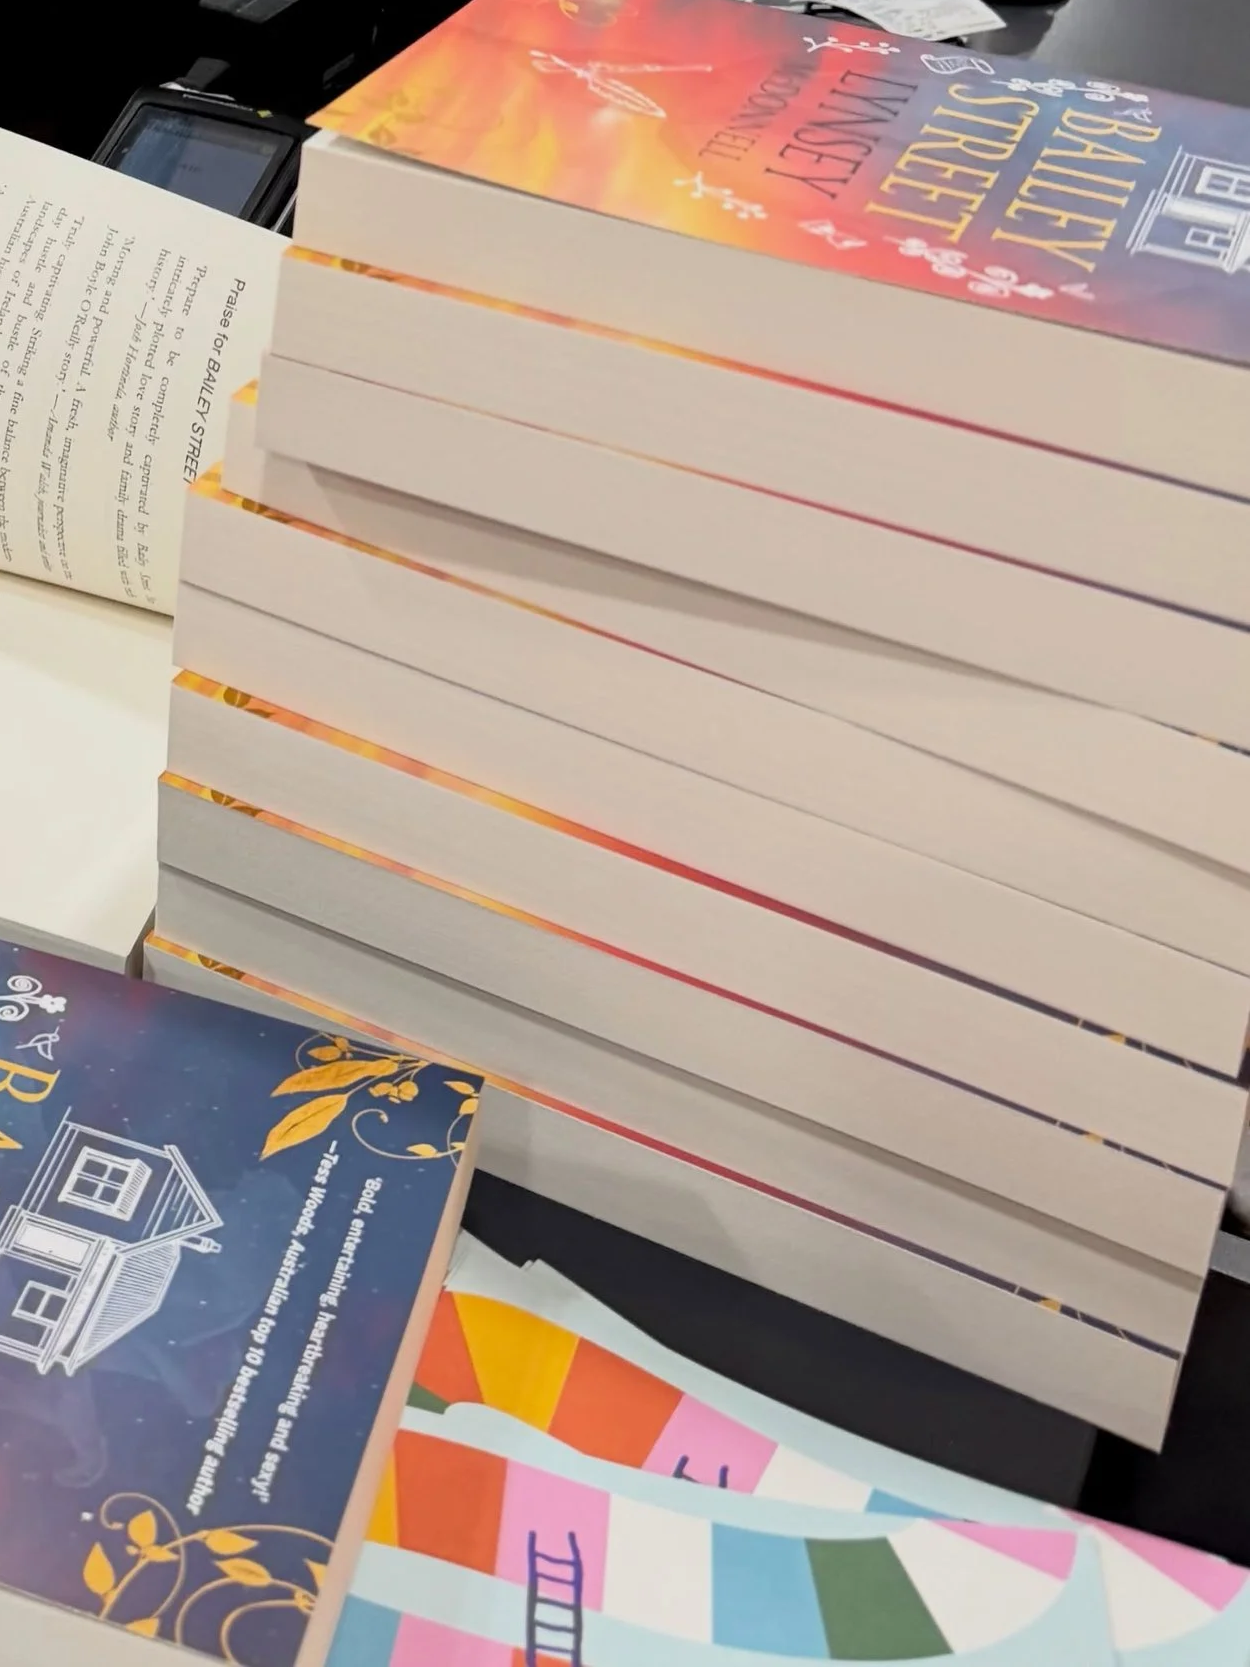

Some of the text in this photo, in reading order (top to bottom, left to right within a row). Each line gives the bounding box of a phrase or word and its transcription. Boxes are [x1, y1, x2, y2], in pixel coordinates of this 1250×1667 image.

[764, 70, 919, 201] LYNSEY
[864, 83, 1040, 244] STREET
[992, 107, 1161, 273] BAILEY
[2, 194, 36, 256] Australian
[17, 200, 53, 265] landscapes
[94, 224, 118, 260] John
[33, 233, 59, 274] hustle
[84, 258, 109, 297] Boyle
[19, 281, 38, 308] and
[219, 277, 246, 328] Praise
[5, 312, 30, 354] bustle
[13, 326, 43, 378] Striking
[161, 347, 181, 367] be
[173, 325, 185, 340] to
[211, 331, 228, 356] for
[4, 388, 24, 415] fine
[55, 287, 112, 503] and fresh, imaginative
[113, 255, 189, 543] intricately plotted love story and family drama
[143, 373, 169, 446] completely
[194, 356, 222, 424] BAILEY
[106, 403, 122, 442] author
[133, 453, 155, 516] captivated
[132, 521, 148, 537] by
[292, 1187, 326, 1236] Woods,
[264, 1239, 305, 1315] Australian
[319, 1219, 364, 1307] entertaining,
[245, 1347, 265, 1365] 10
[251, 1317, 276, 1344] top
[278, 1311, 336, 1417] heartbreaking
[205, 1366, 258, 1456] bestselling
[270, 1418, 292, 1451] and
[186, 1455, 219, 1515] author
